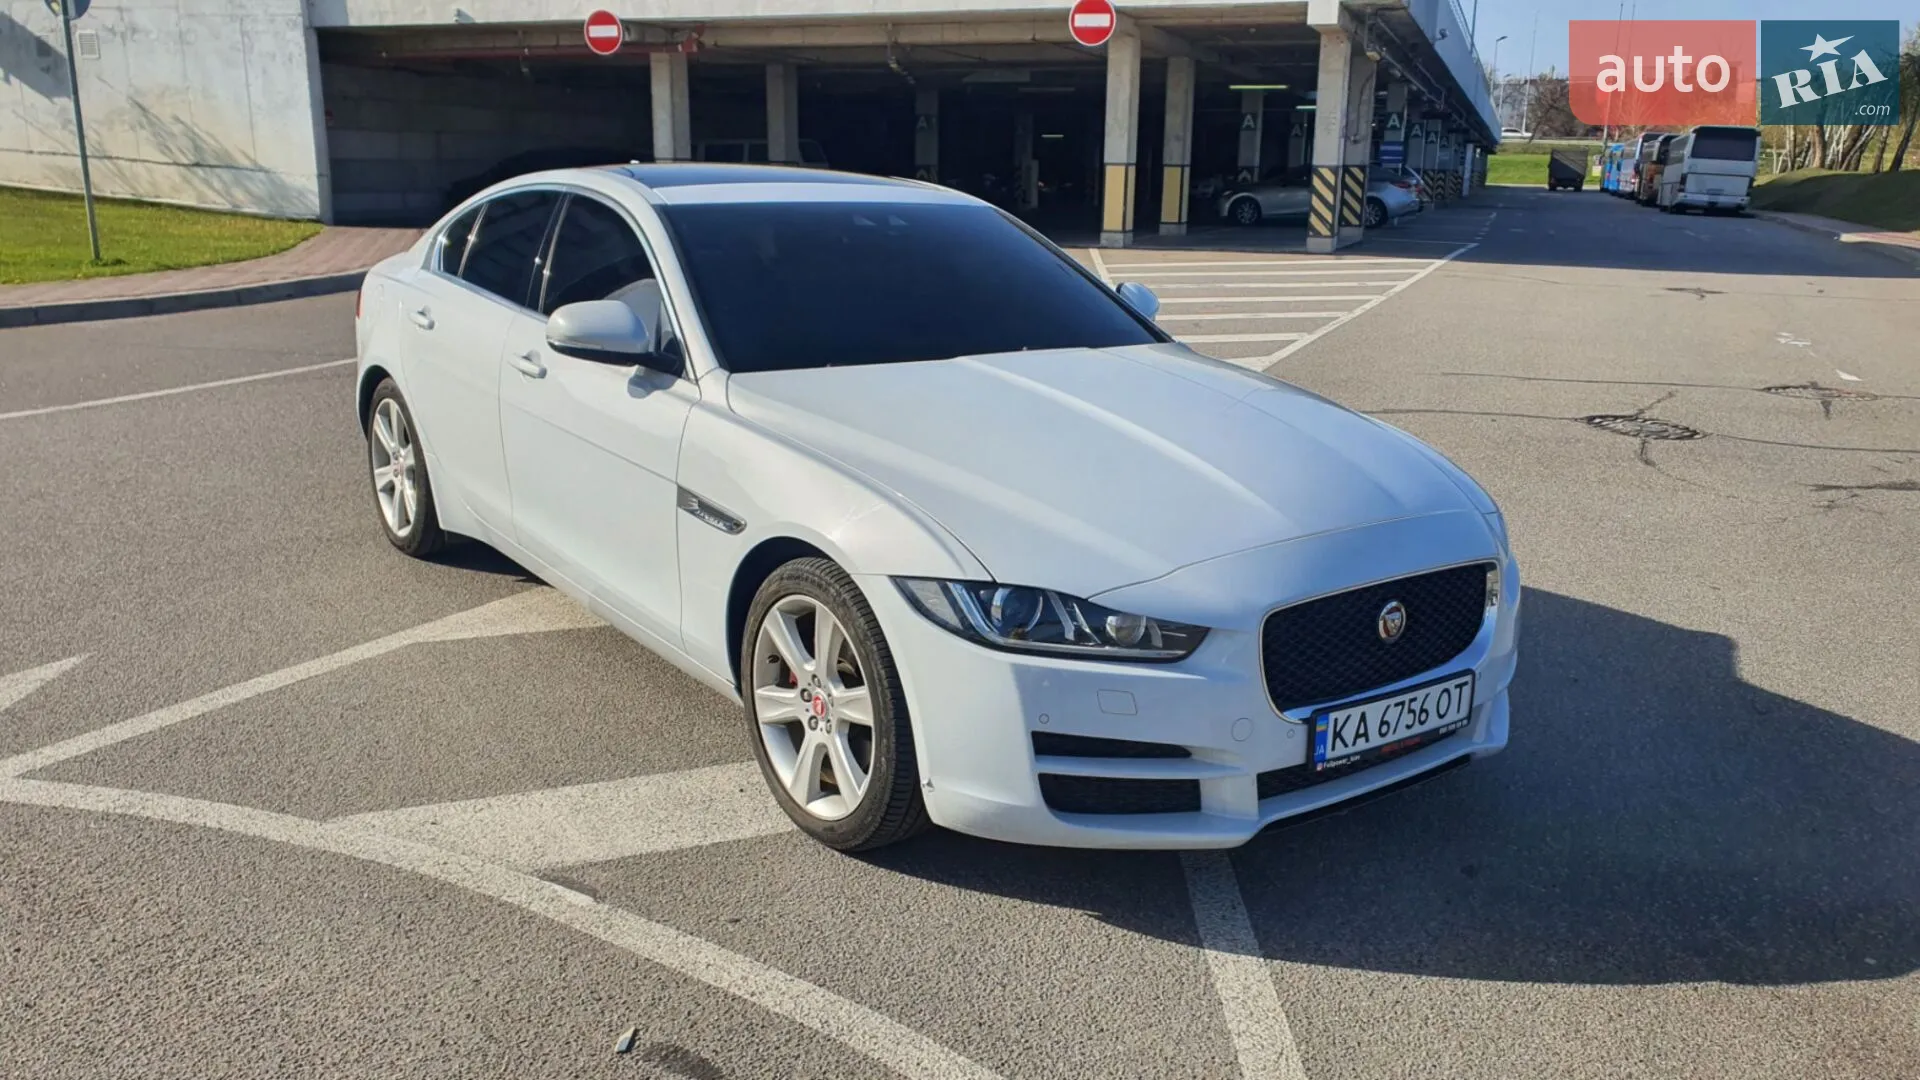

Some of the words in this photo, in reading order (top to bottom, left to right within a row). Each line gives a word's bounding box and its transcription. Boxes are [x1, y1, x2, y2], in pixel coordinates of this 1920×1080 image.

[1242, 114, 1255, 129] A
[1386, 113, 1400, 128] A
[1291, 123, 1302, 137] A
[1410, 123, 1422, 137] A
[1426, 132, 1437, 144] A
[1331, 711, 1370, 752] KA
[1378, 692, 1431, 739] 6756
[1436, 681, 1469, 720] OT
